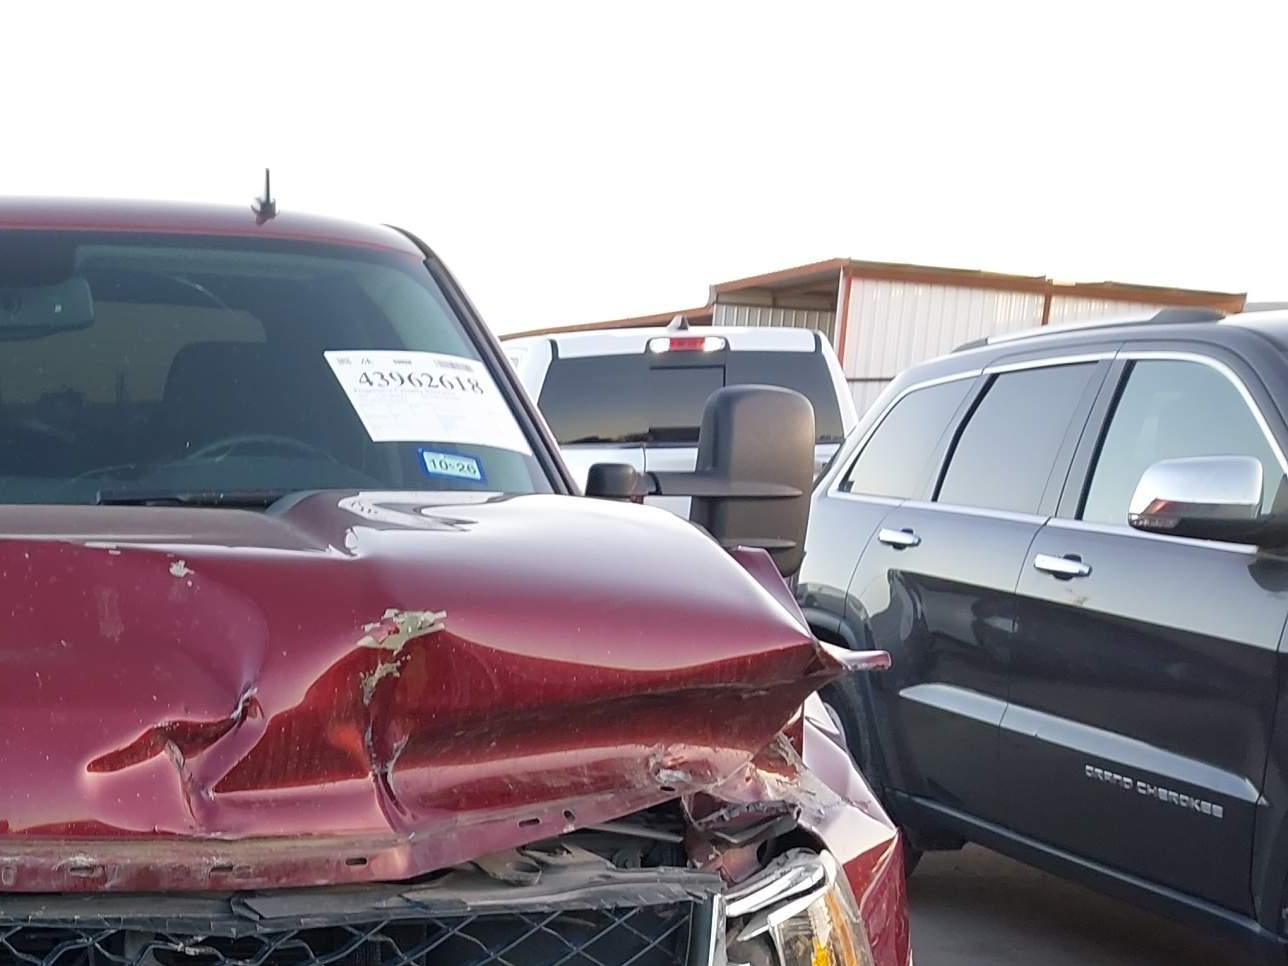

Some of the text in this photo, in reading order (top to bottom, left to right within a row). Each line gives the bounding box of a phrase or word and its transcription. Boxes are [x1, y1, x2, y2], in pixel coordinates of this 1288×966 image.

[358, 371, 484, 395] 43962618
[430, 458, 478, 476] 10-26
[1084, 764, 1224, 818] GRAND CHEROKEE
